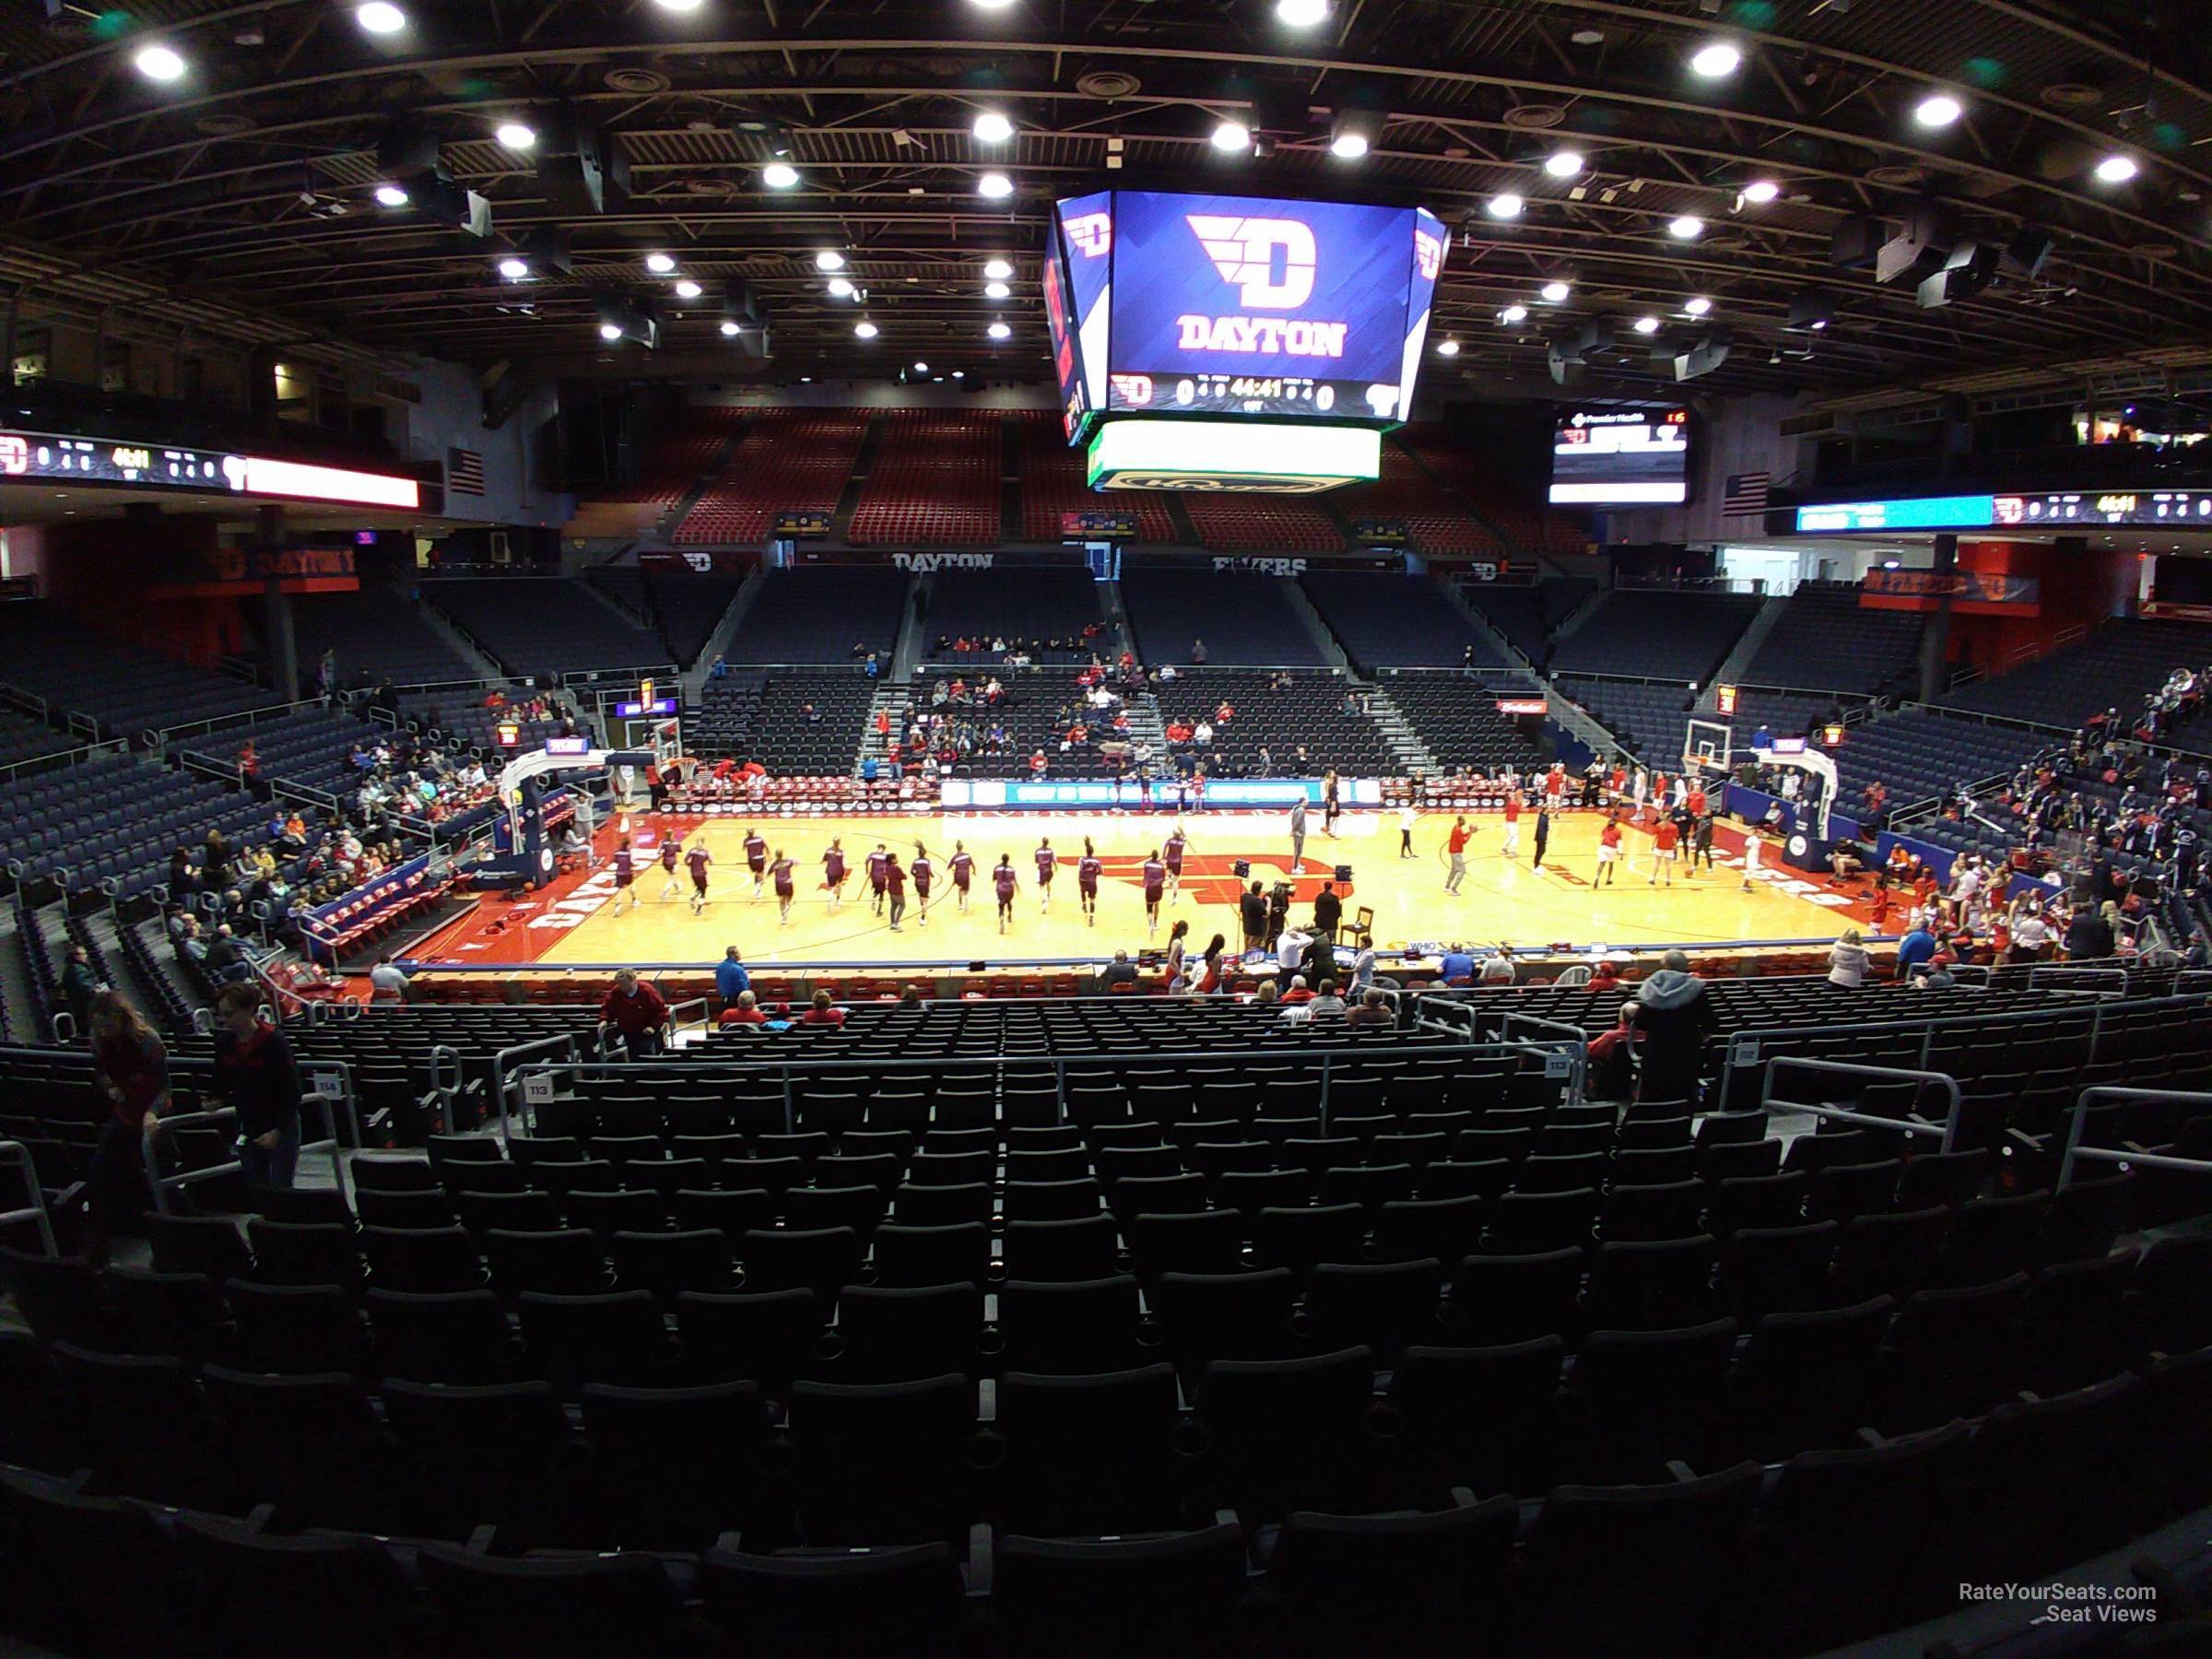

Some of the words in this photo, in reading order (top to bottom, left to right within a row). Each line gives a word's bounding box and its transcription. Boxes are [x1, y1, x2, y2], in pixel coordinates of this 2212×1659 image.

[1178, 314, 1347, 357] DAYTON
[1198, 382, 1208, 396] 4
[1230, 378, 1281, 397] 44:41
[1302, 387, 1312, 400] 4
[892, 553, 994, 572] DAYTON
[1410, 942, 1436, 950] WHIO
[530, 1085, 548, 1096] 113
